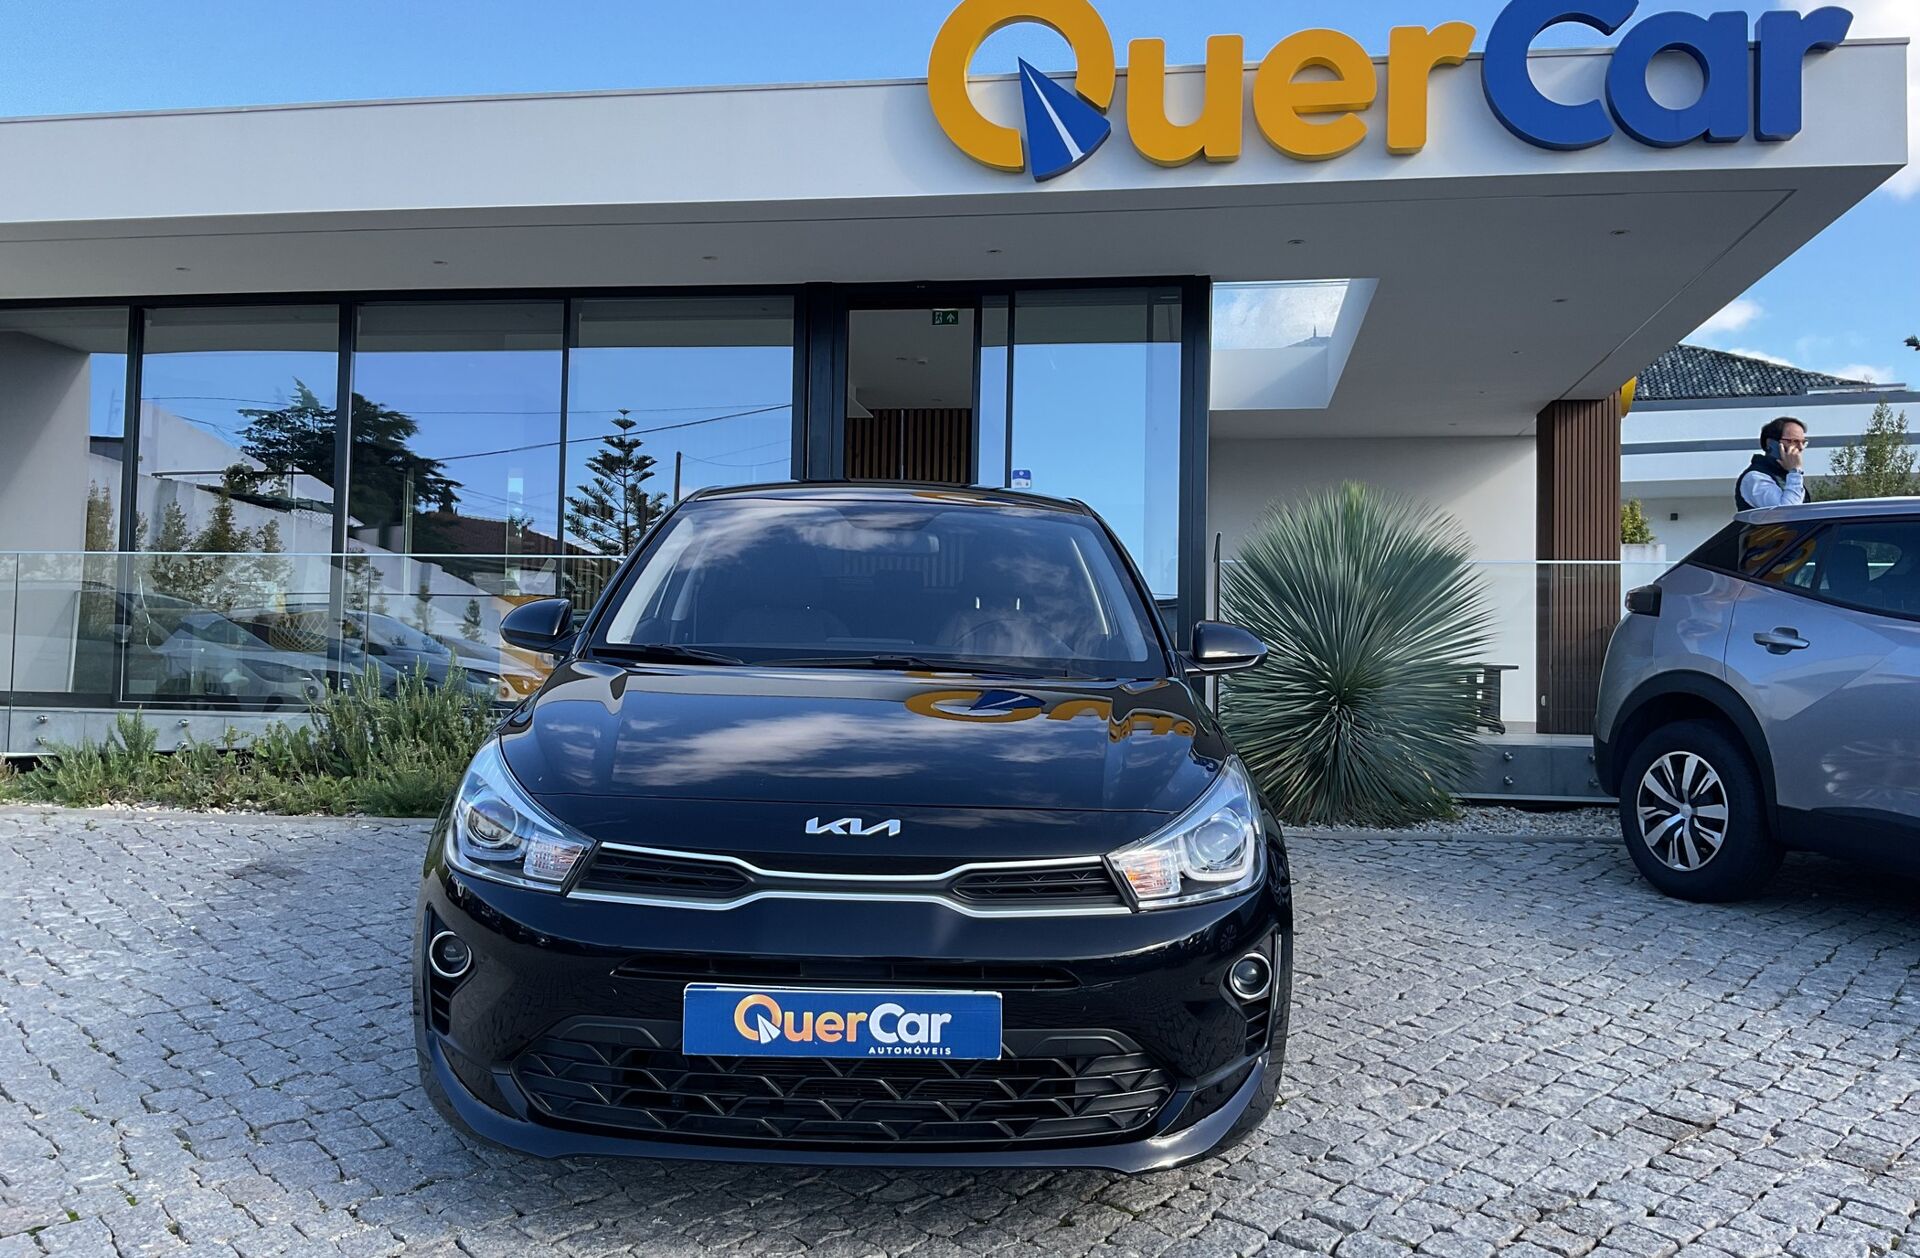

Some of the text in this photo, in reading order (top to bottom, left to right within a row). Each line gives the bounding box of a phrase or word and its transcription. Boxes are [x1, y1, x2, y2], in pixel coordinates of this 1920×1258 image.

[927, 0, 1853, 182] QuerCar
[805, 817, 901, 837] KIA
[733, 994, 952, 1044] QuerCar
[868, 1045, 952, 1055] AUTOMÓVEIS
